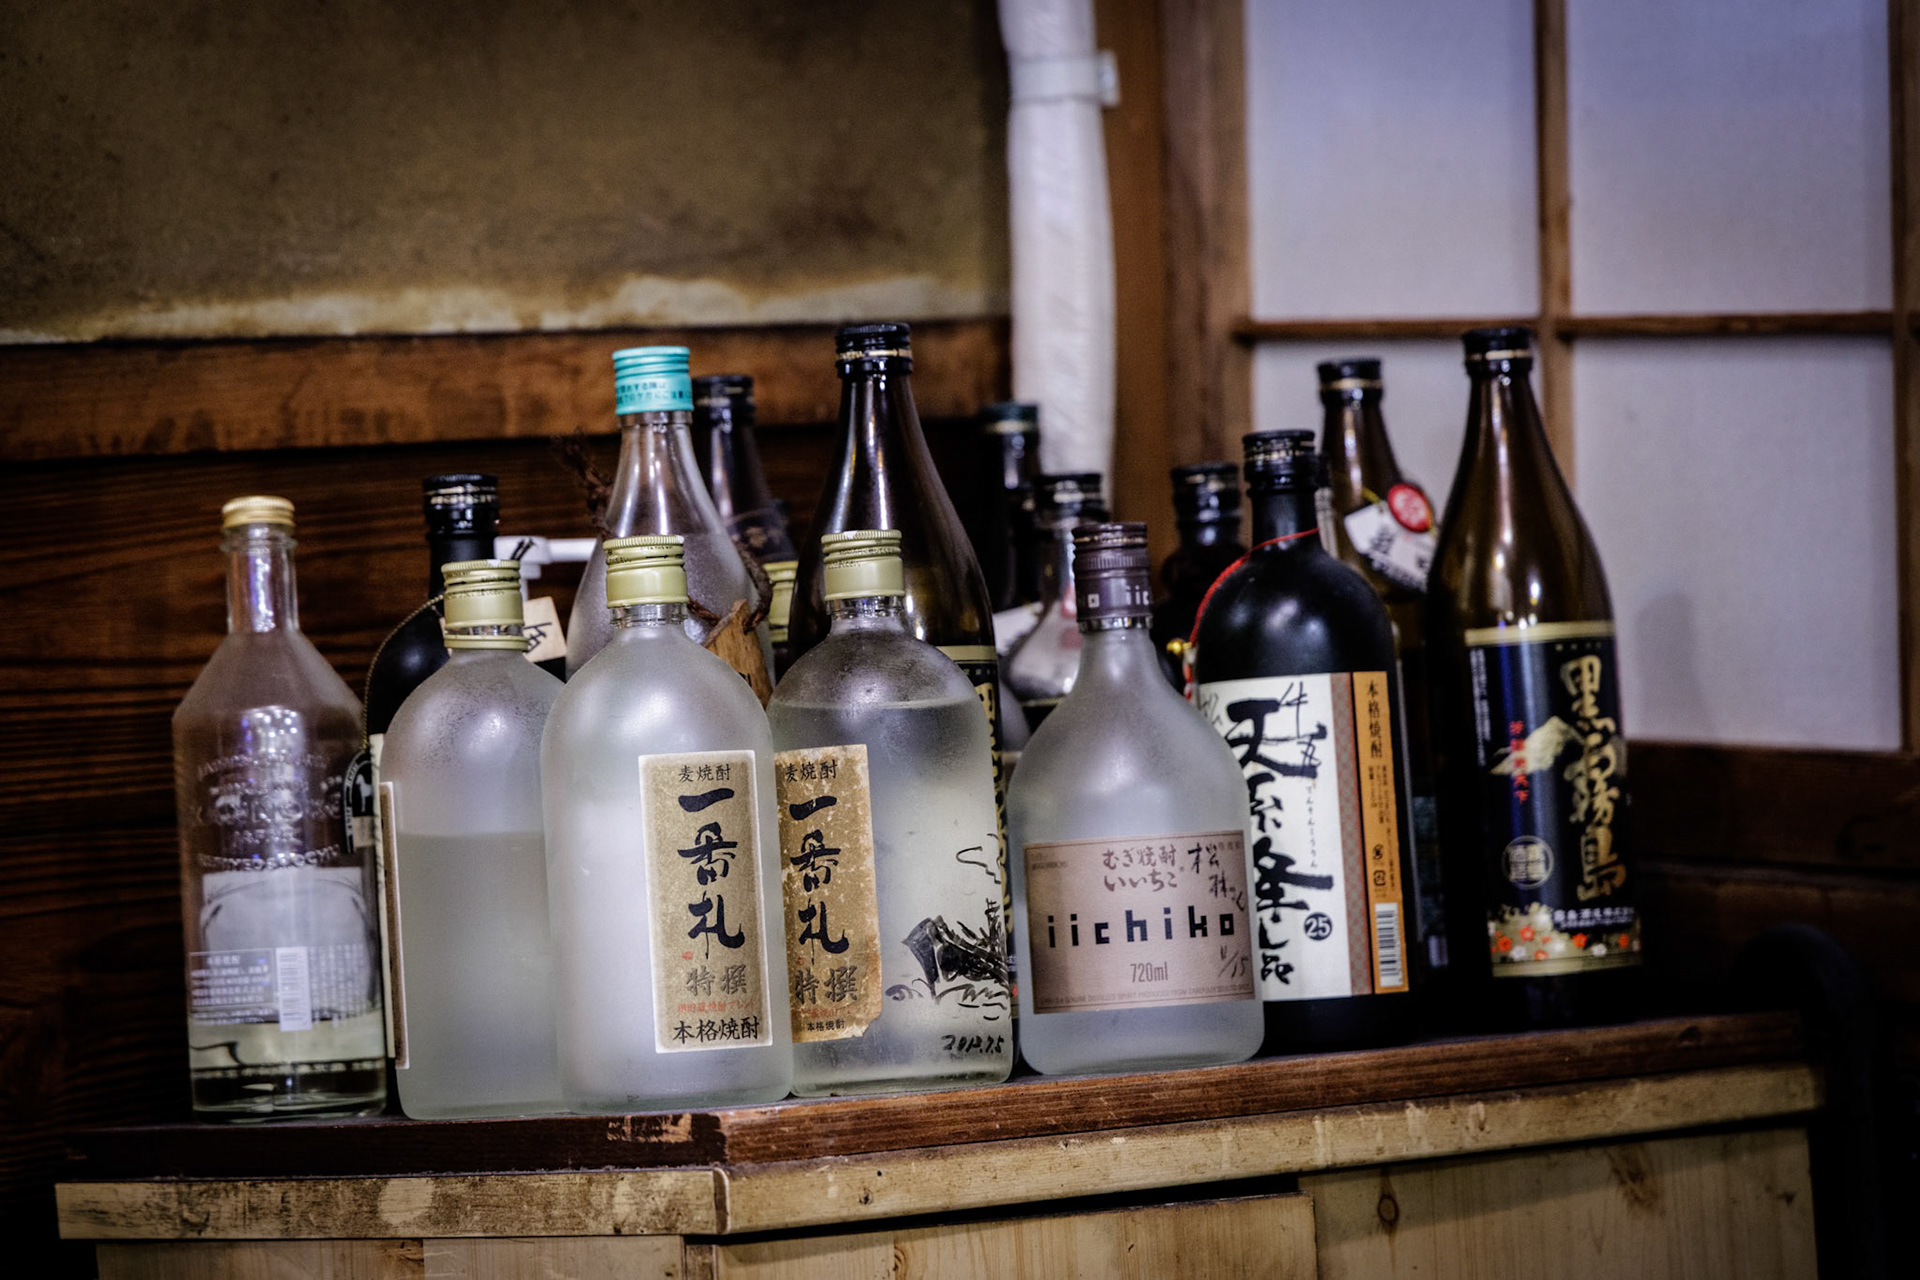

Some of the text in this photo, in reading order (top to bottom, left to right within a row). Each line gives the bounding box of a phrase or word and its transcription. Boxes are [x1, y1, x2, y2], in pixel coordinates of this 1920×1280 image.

[1367, 678, 1383, 759] 本格焼酎
[678, 763, 732, 784] 麦焼酎
[784, 759, 838, 783] 麦焼酎
[1102, 843, 1177, 870] むぎ焼酎
[677, 787, 746, 960] 一番札
[789, 795, 850, 966] 一番札
[1104, 869, 1178, 892] いいちこ
[1048, 905, 1235, 948] iichiko
[1308, 917, 1328, 933] 25
[1130, 961, 1169, 984] 720ml
[673, 1015, 760, 1045] 本格焼酎
